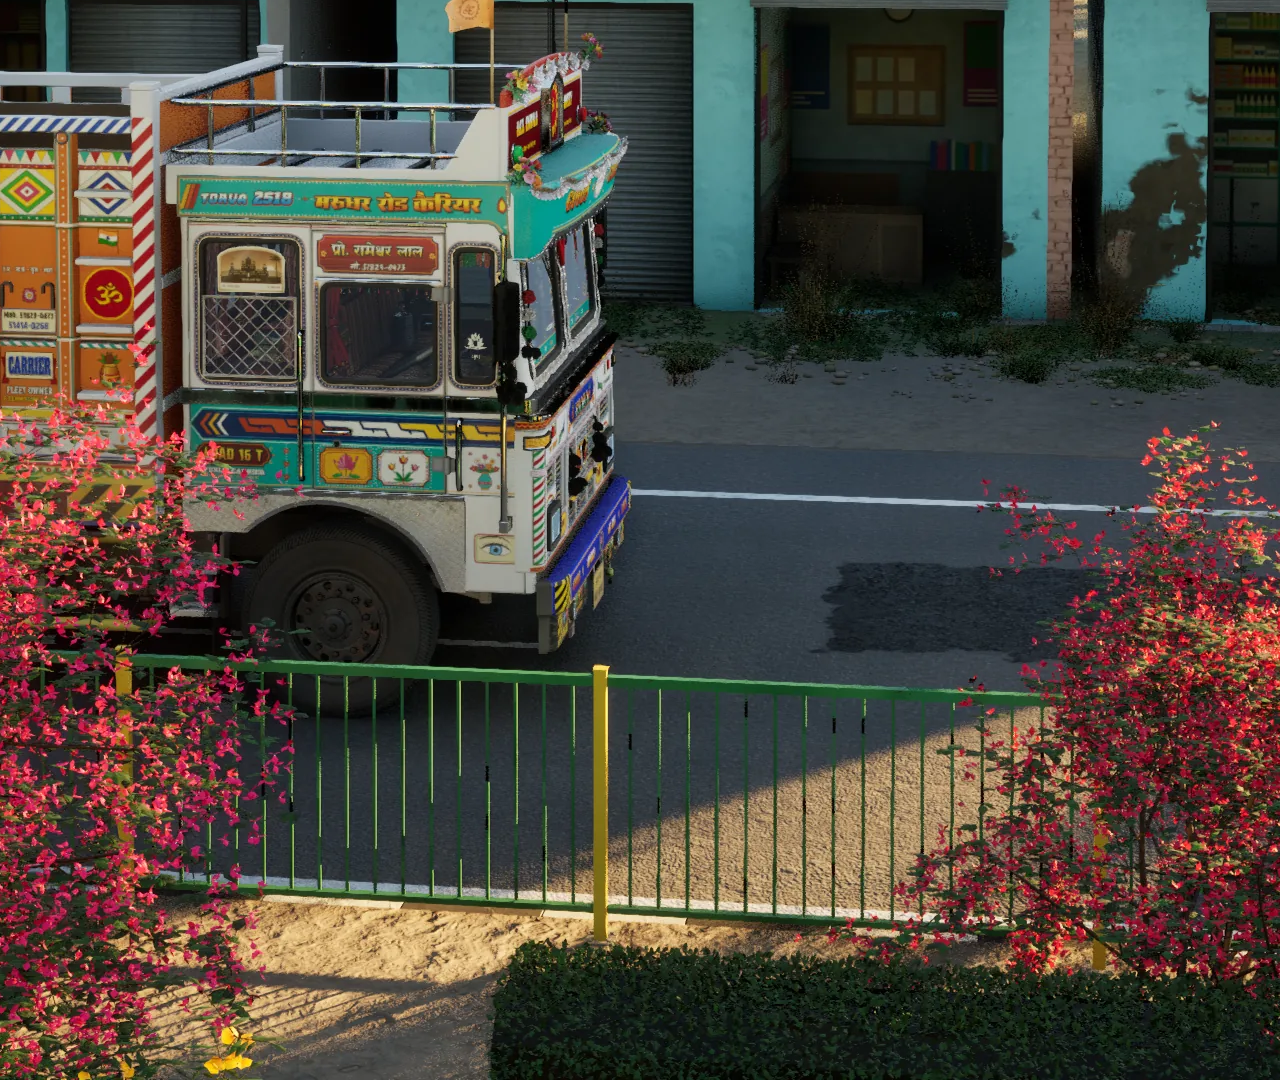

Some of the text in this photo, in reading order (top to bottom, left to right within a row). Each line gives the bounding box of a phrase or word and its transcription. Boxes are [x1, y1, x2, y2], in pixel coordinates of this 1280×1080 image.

[252, 190, 295, 207] 2518
[314, 190, 483, 214] मरुधर रोड कैरियर
[330, 240, 425, 259] प्रो. रामेश्वर लाल
[7, 354, 52, 376] CARRIER
[255, 448, 264, 463] T
